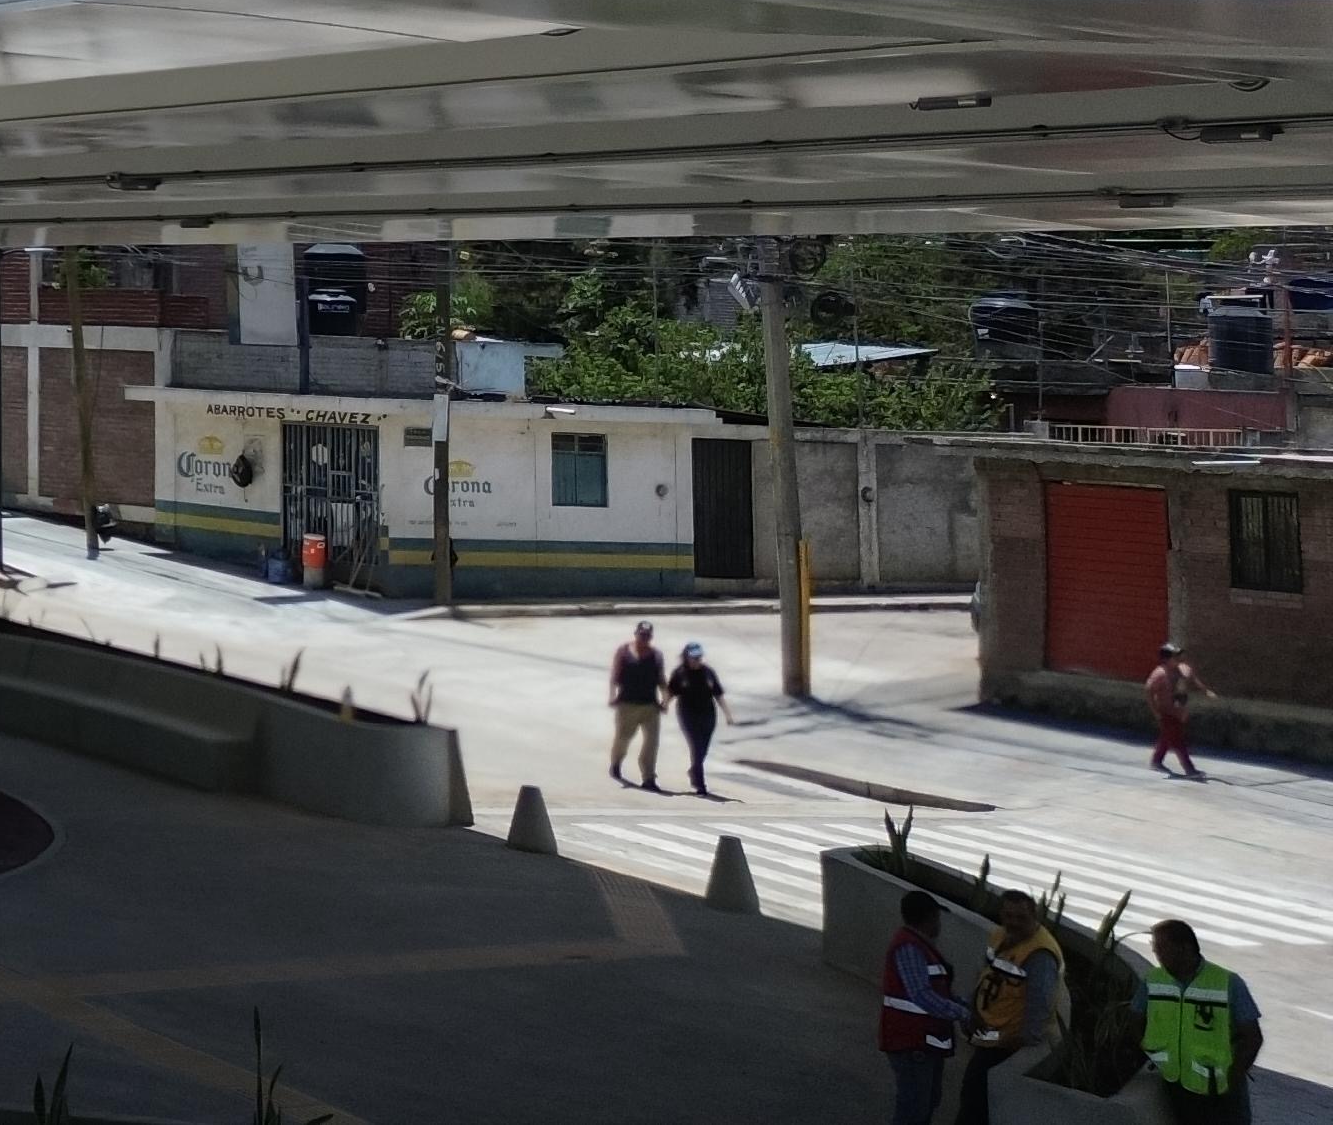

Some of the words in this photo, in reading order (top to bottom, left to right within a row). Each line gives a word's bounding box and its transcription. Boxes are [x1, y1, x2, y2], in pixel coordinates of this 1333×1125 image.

[206, 403, 286, 420] ABARROTES
[195, 479, 226, 495] Extra
[423, 475, 493, 496] Crona
[449, 497, 475, 508] xtra
